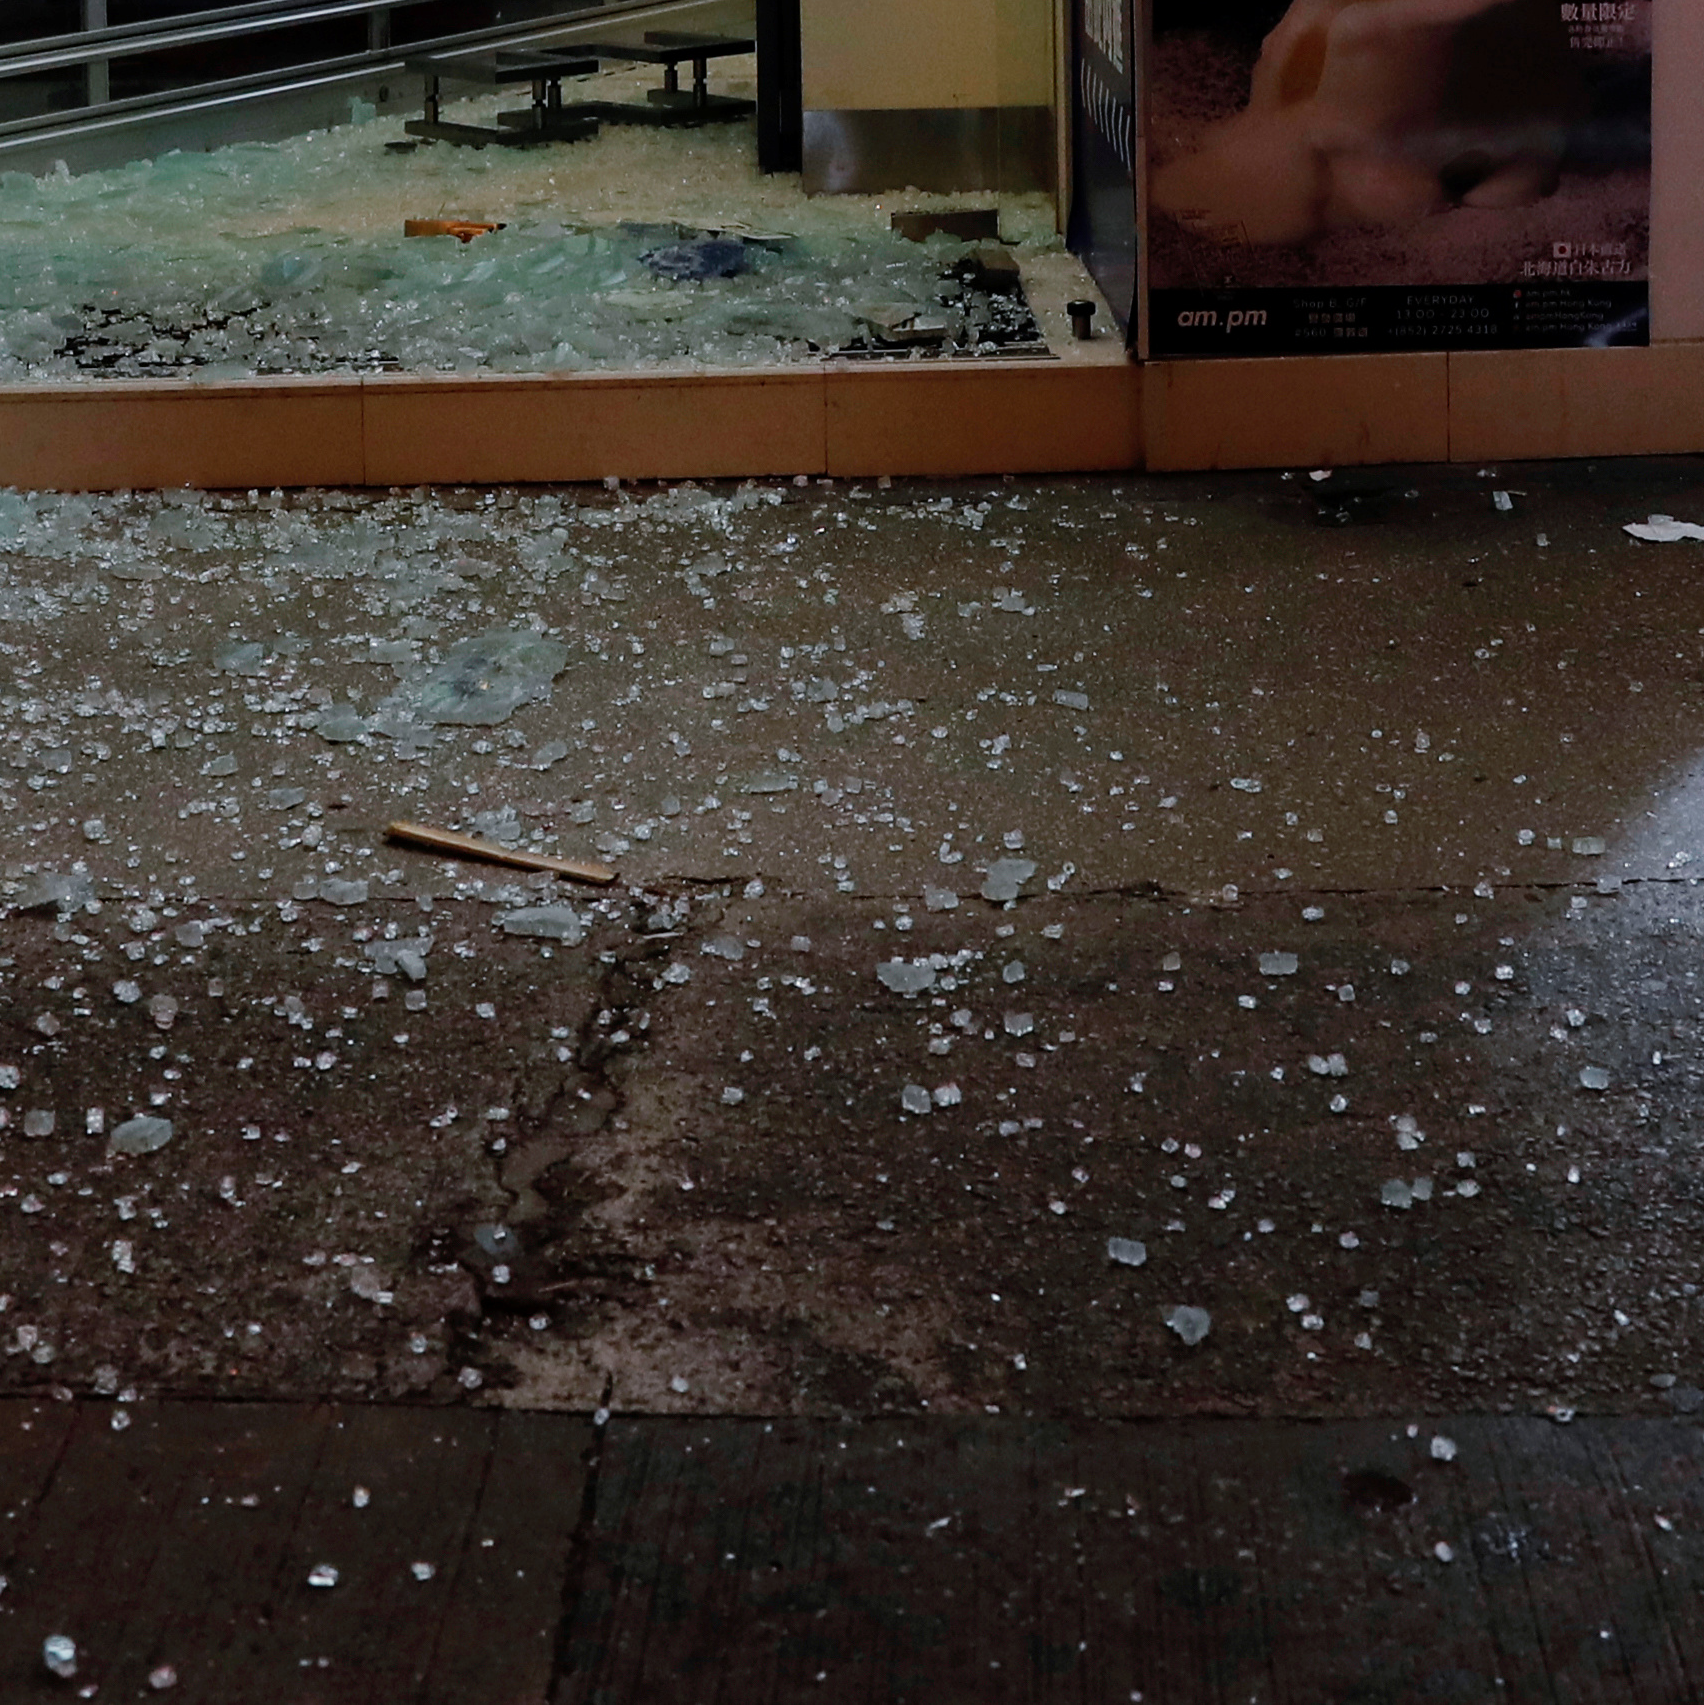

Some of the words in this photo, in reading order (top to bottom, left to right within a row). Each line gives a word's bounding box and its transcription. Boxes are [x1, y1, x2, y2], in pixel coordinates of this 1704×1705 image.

[1561, 2, 1635, 22] 數量限定
[1520, 259, 1631, 276] 北海道白朱古力
[1407, 295, 1475, 306] EVERYDAY
[1177, 309, 1268, 334] am.pm
[1432, 324, 1462, 335] 2725
